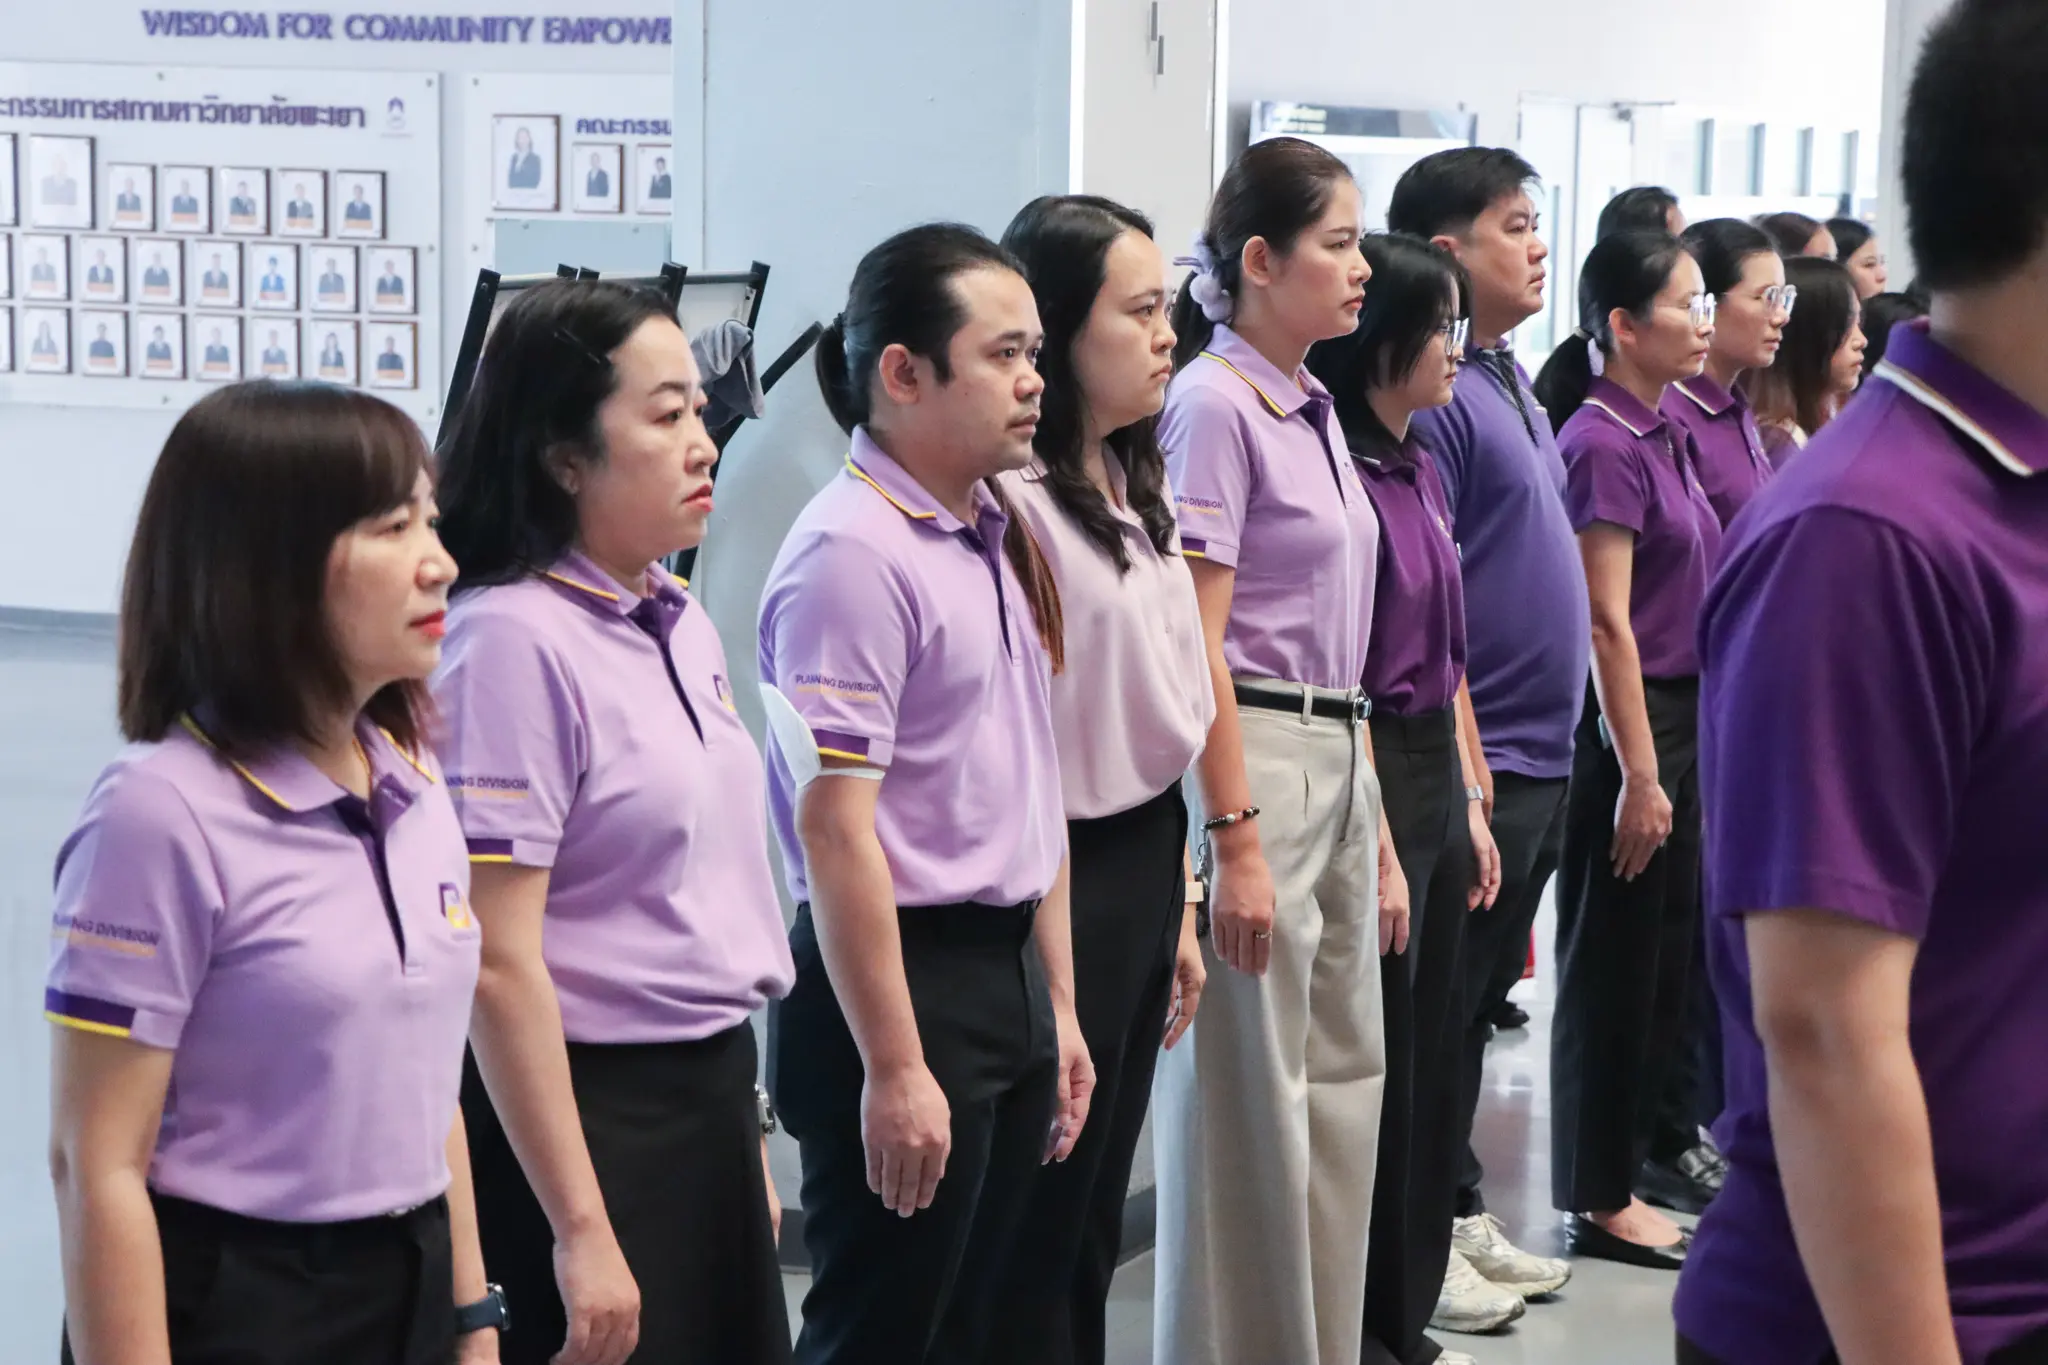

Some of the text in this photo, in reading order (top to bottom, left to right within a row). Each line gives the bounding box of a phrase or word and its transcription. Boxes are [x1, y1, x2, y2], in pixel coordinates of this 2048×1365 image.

[141, 10, 270, 38] WISDOM
[277, 12, 332, 39] FOR
[344, 14, 535, 43] COMMUNITY
[1189, 497, 1223, 509] DIVISION
[838, 680, 881, 693] DIVISION
[477, 777, 530, 790] DIVISION
[95, 922, 162, 947] DIVISION
